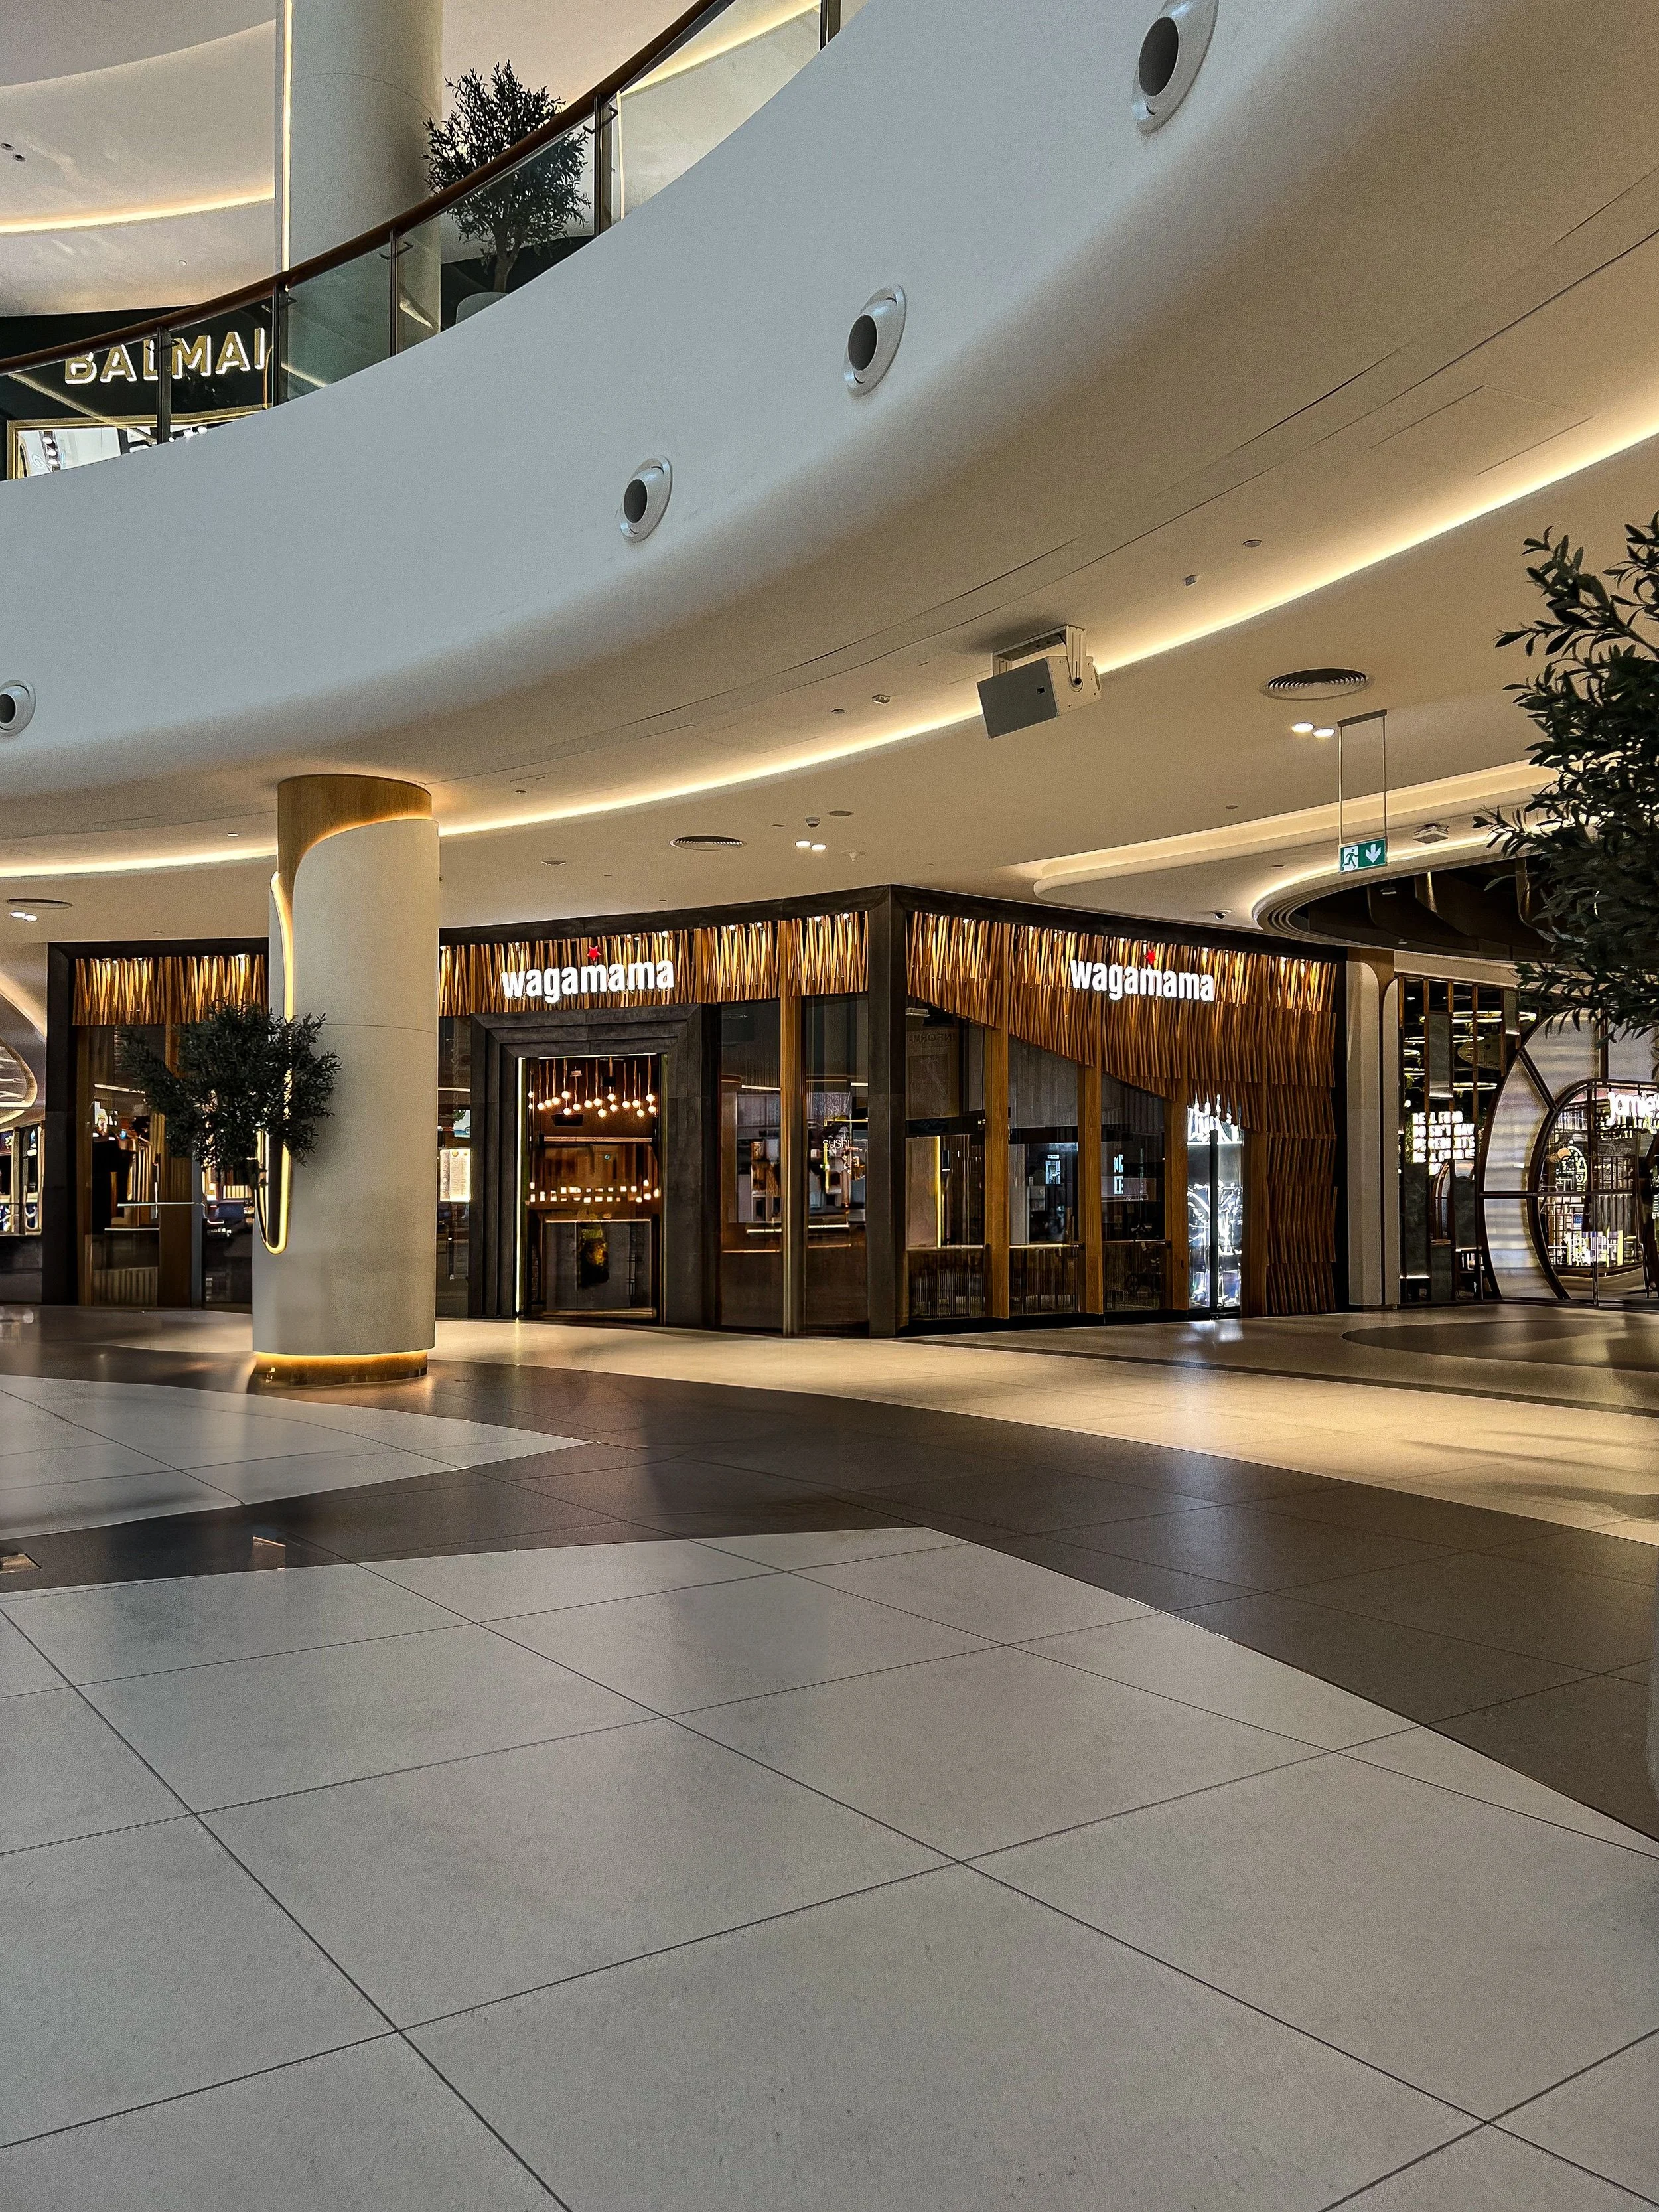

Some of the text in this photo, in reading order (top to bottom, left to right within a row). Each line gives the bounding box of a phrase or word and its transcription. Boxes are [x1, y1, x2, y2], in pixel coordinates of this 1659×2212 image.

[501, 960, 675, 1004] wagamama
[1070, 960, 1215, 1001] wagamama
[822, 1136, 850, 1149] sushi
